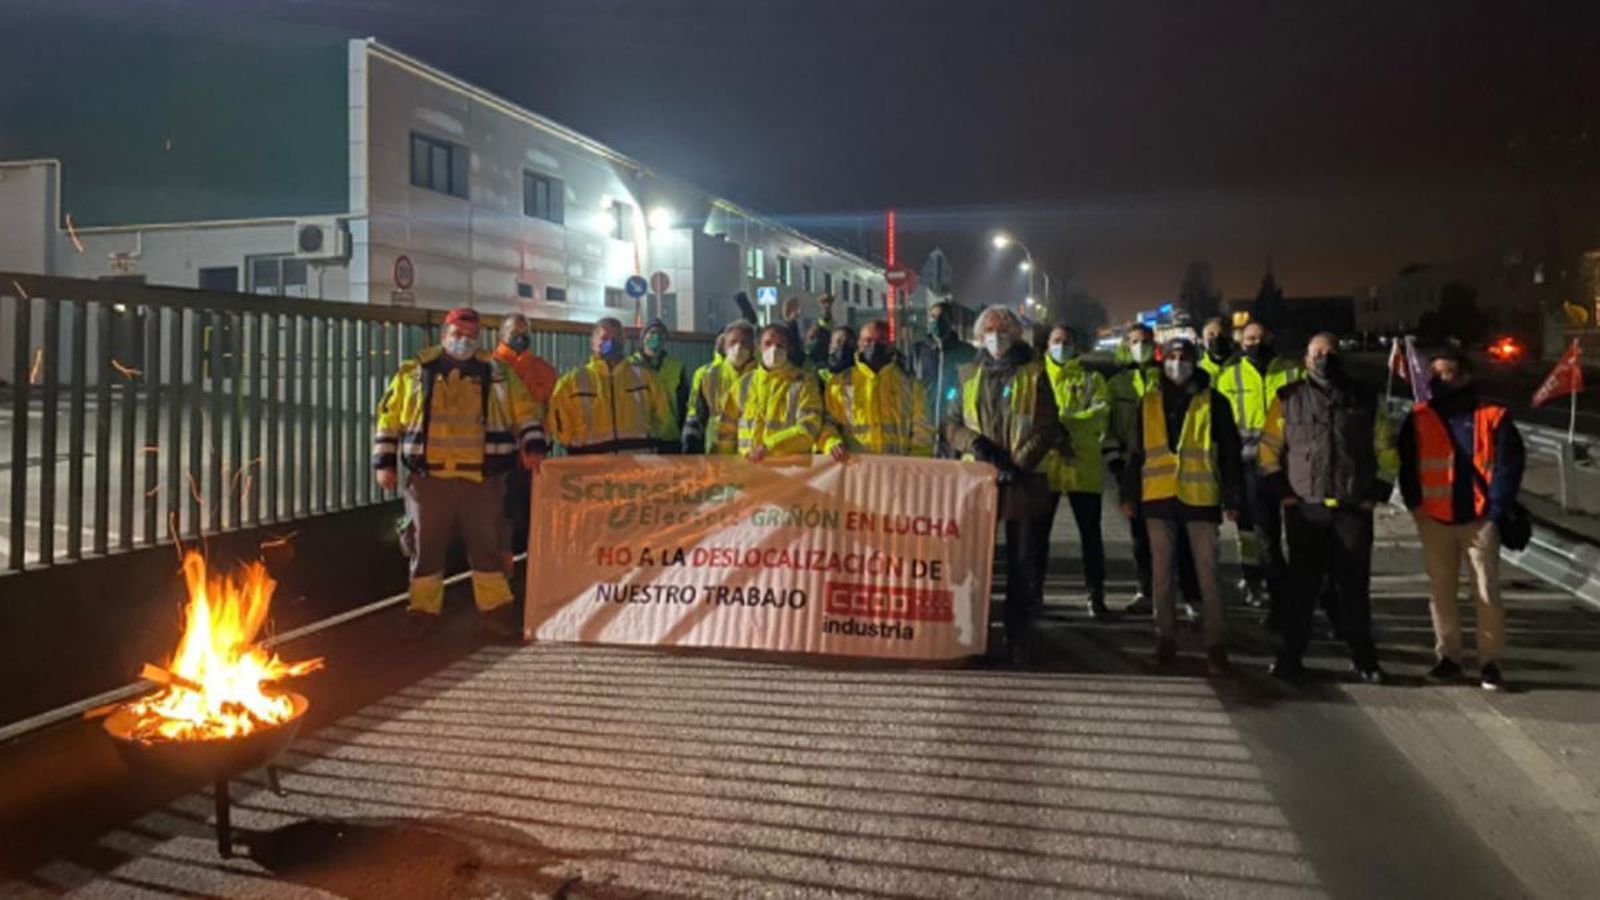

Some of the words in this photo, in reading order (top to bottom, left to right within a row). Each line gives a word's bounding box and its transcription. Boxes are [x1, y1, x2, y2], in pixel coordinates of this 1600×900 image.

[845, 511, 876, 532] EN
[883, 514, 960, 538] LUCHA
[639, 547, 654, 566] A
[661, 547, 686, 566] LA
[692, 547, 903, 577] DESLOCALIZACIÓN
[911, 559, 942, 580] DE
[595, 585, 697, 604] NUESTRO
[704, 586, 808, 609] TRABAJO
[822, 616, 914, 640] industria
